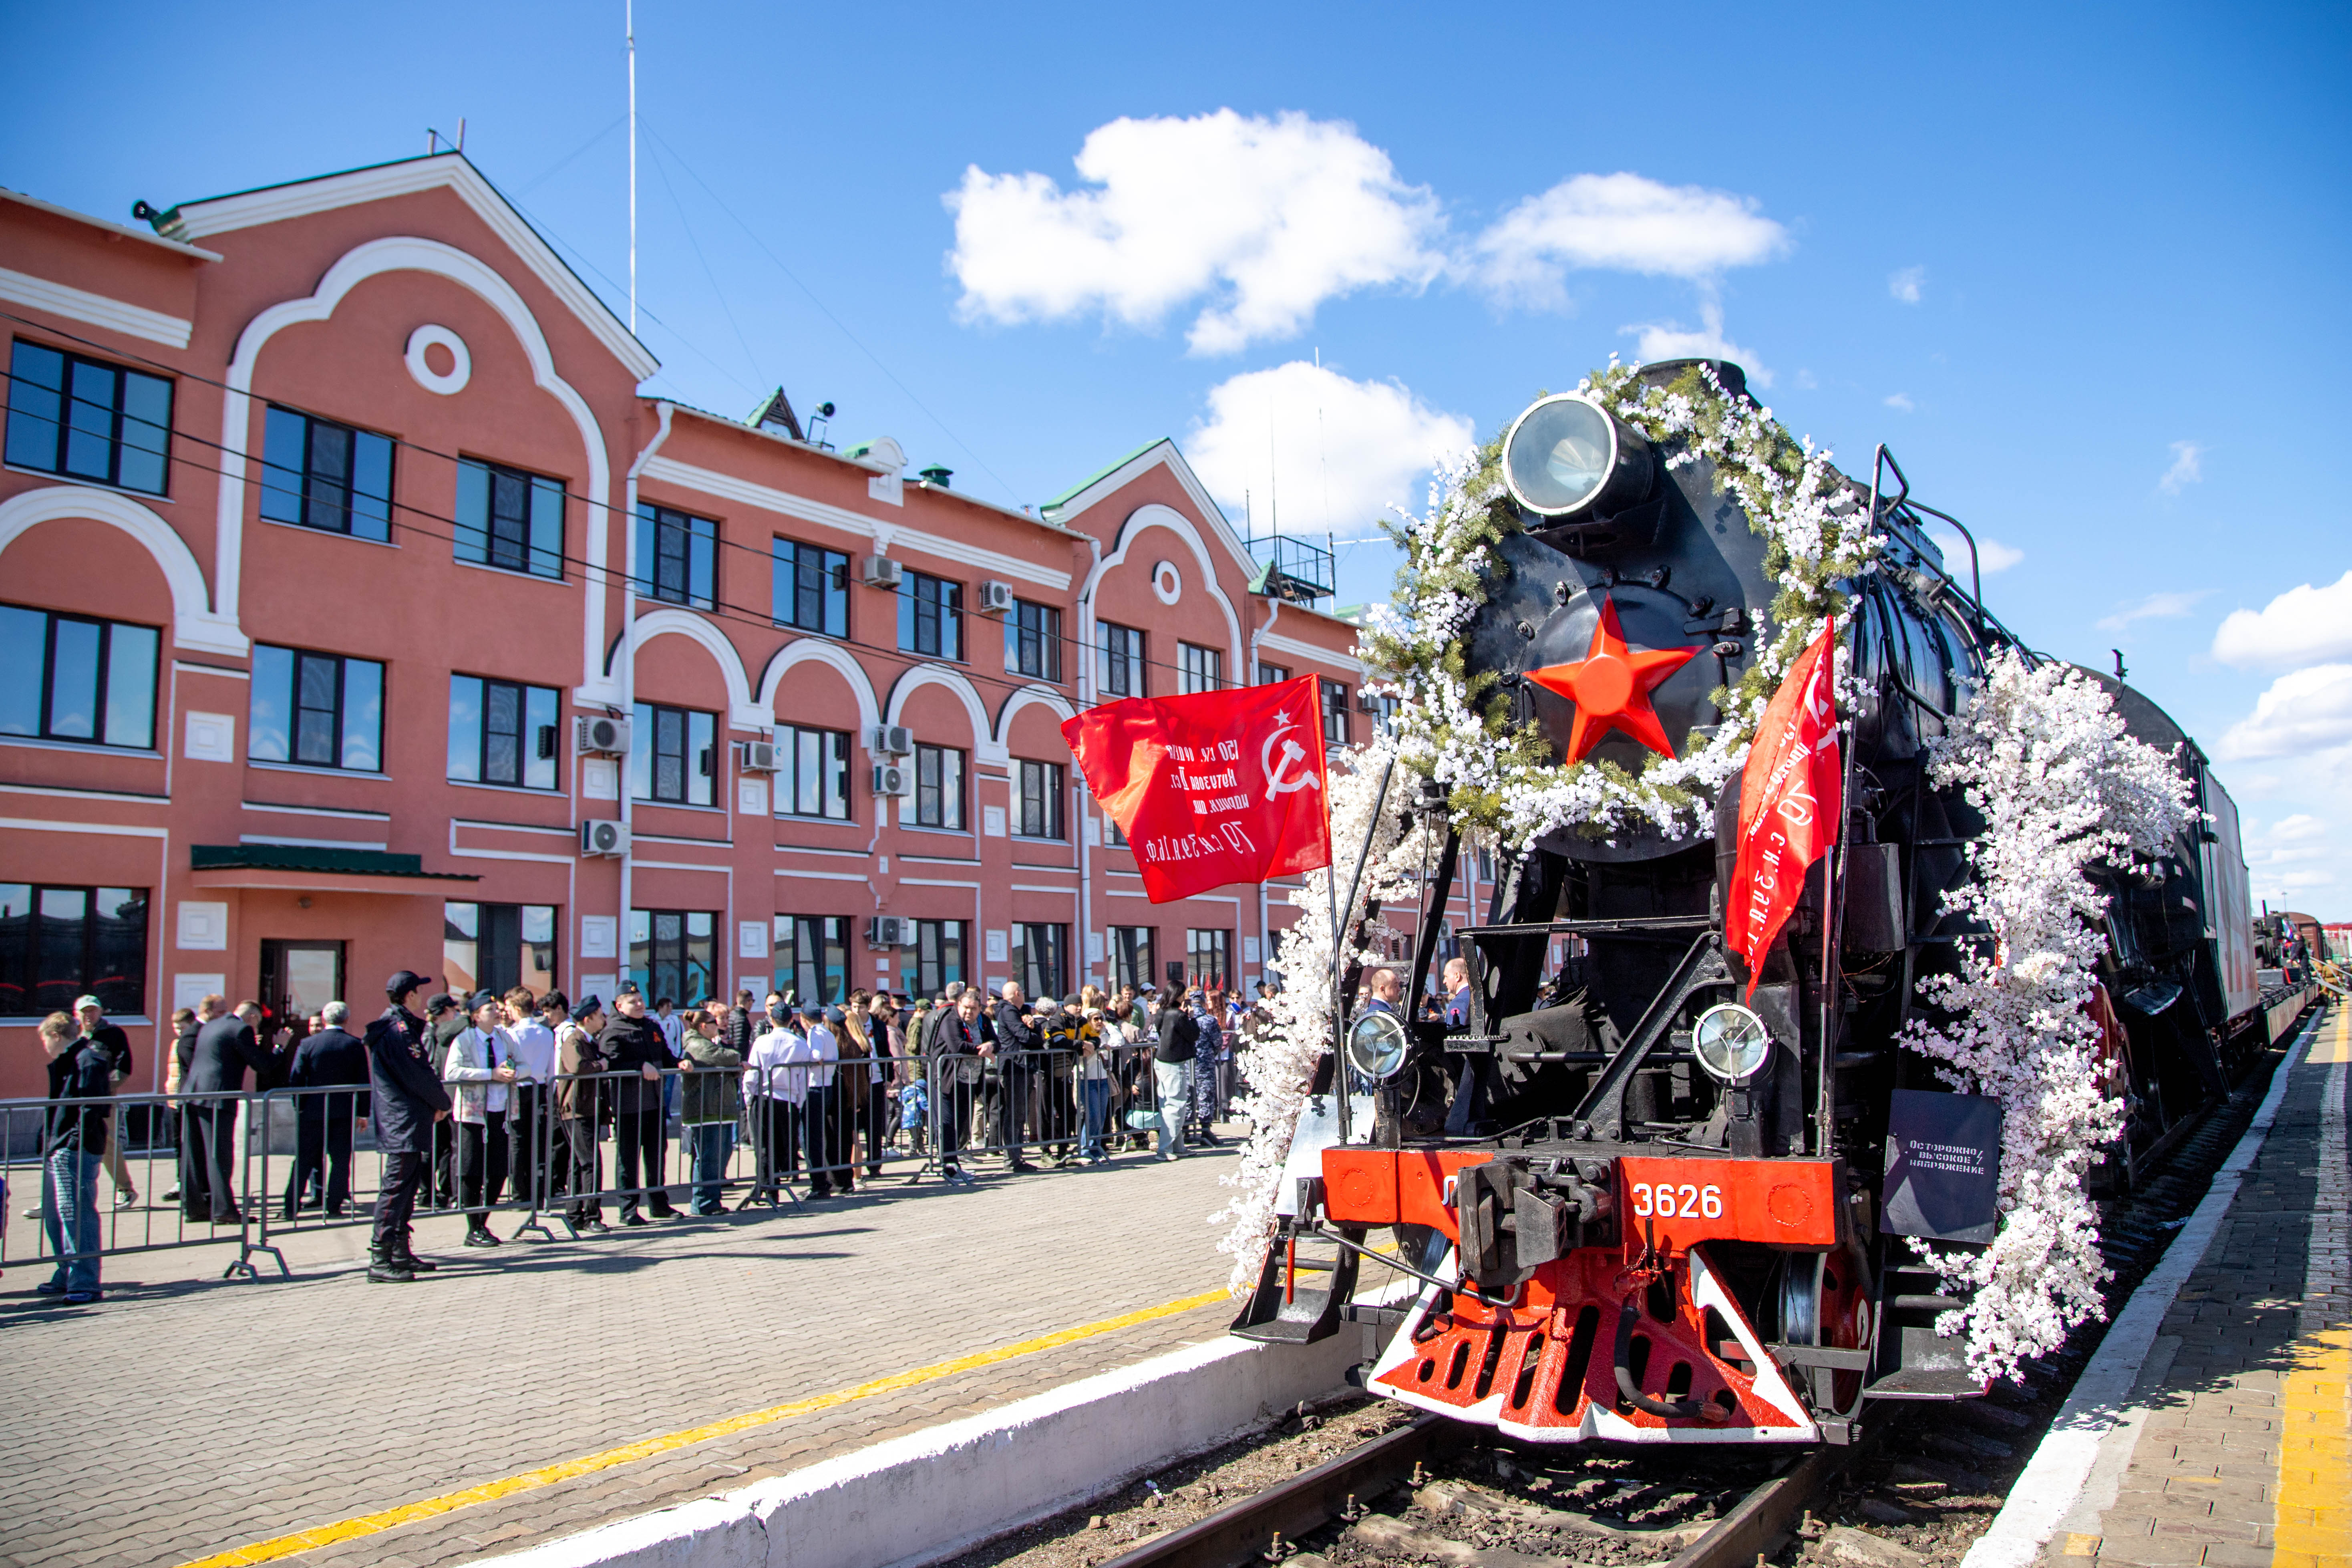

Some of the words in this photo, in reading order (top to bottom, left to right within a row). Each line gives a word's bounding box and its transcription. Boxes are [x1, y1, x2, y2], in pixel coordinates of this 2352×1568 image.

[1909, 1140, 1977, 1155] ОСТОРОЖНО
[1919, 1151, 1971, 1163] ВЫСОКОЕ
[1909, 1159, 1984, 1174] НАПРЯЖЕНИЕ
[1633, 1183, 1722, 1218] 3626
